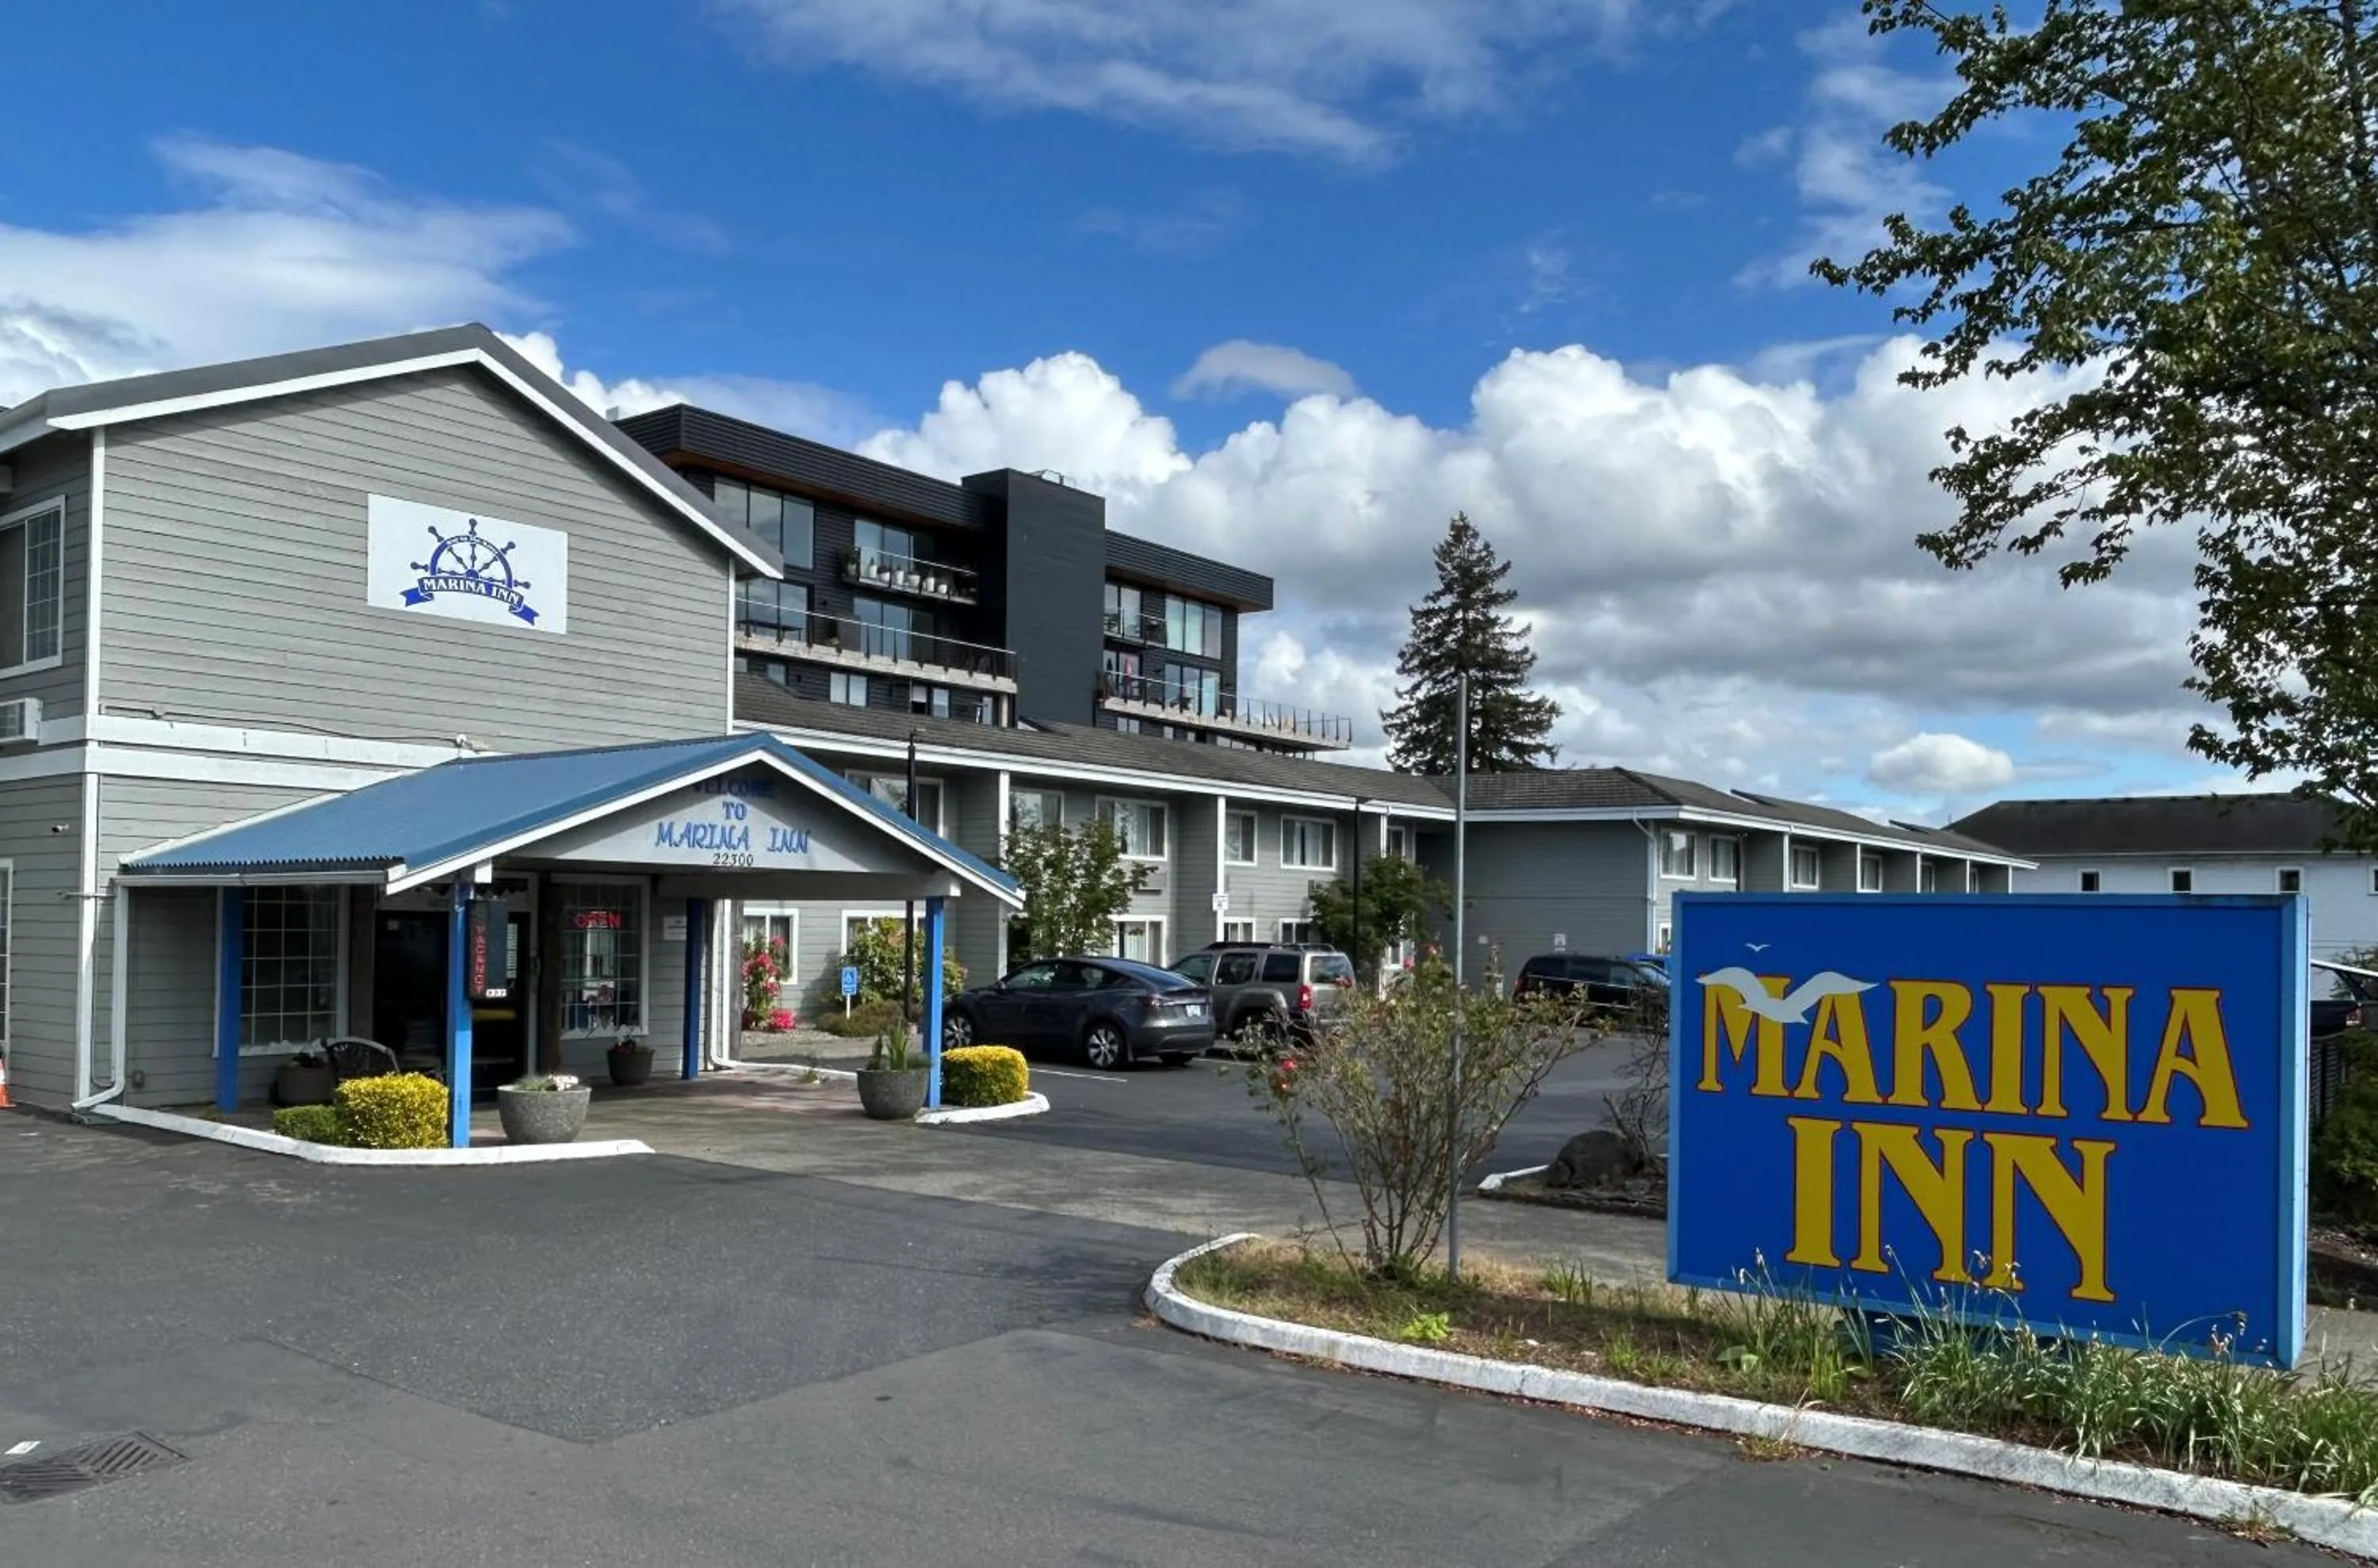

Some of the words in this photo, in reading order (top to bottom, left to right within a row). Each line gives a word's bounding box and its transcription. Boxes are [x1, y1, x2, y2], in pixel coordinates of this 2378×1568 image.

[423, 578, 486, 594] MARINA
[491, 586, 519, 605] INN
[723, 801, 747, 820] TO
[655, 821, 750, 851] MARINA
[767, 827, 810, 854] INN
[713, 852, 754, 867] 22300
[575, 912, 620, 927] OPEN
[1696, 974, 2250, 1129] MARINA
[1784, 1116, 2119, 1303] INN
